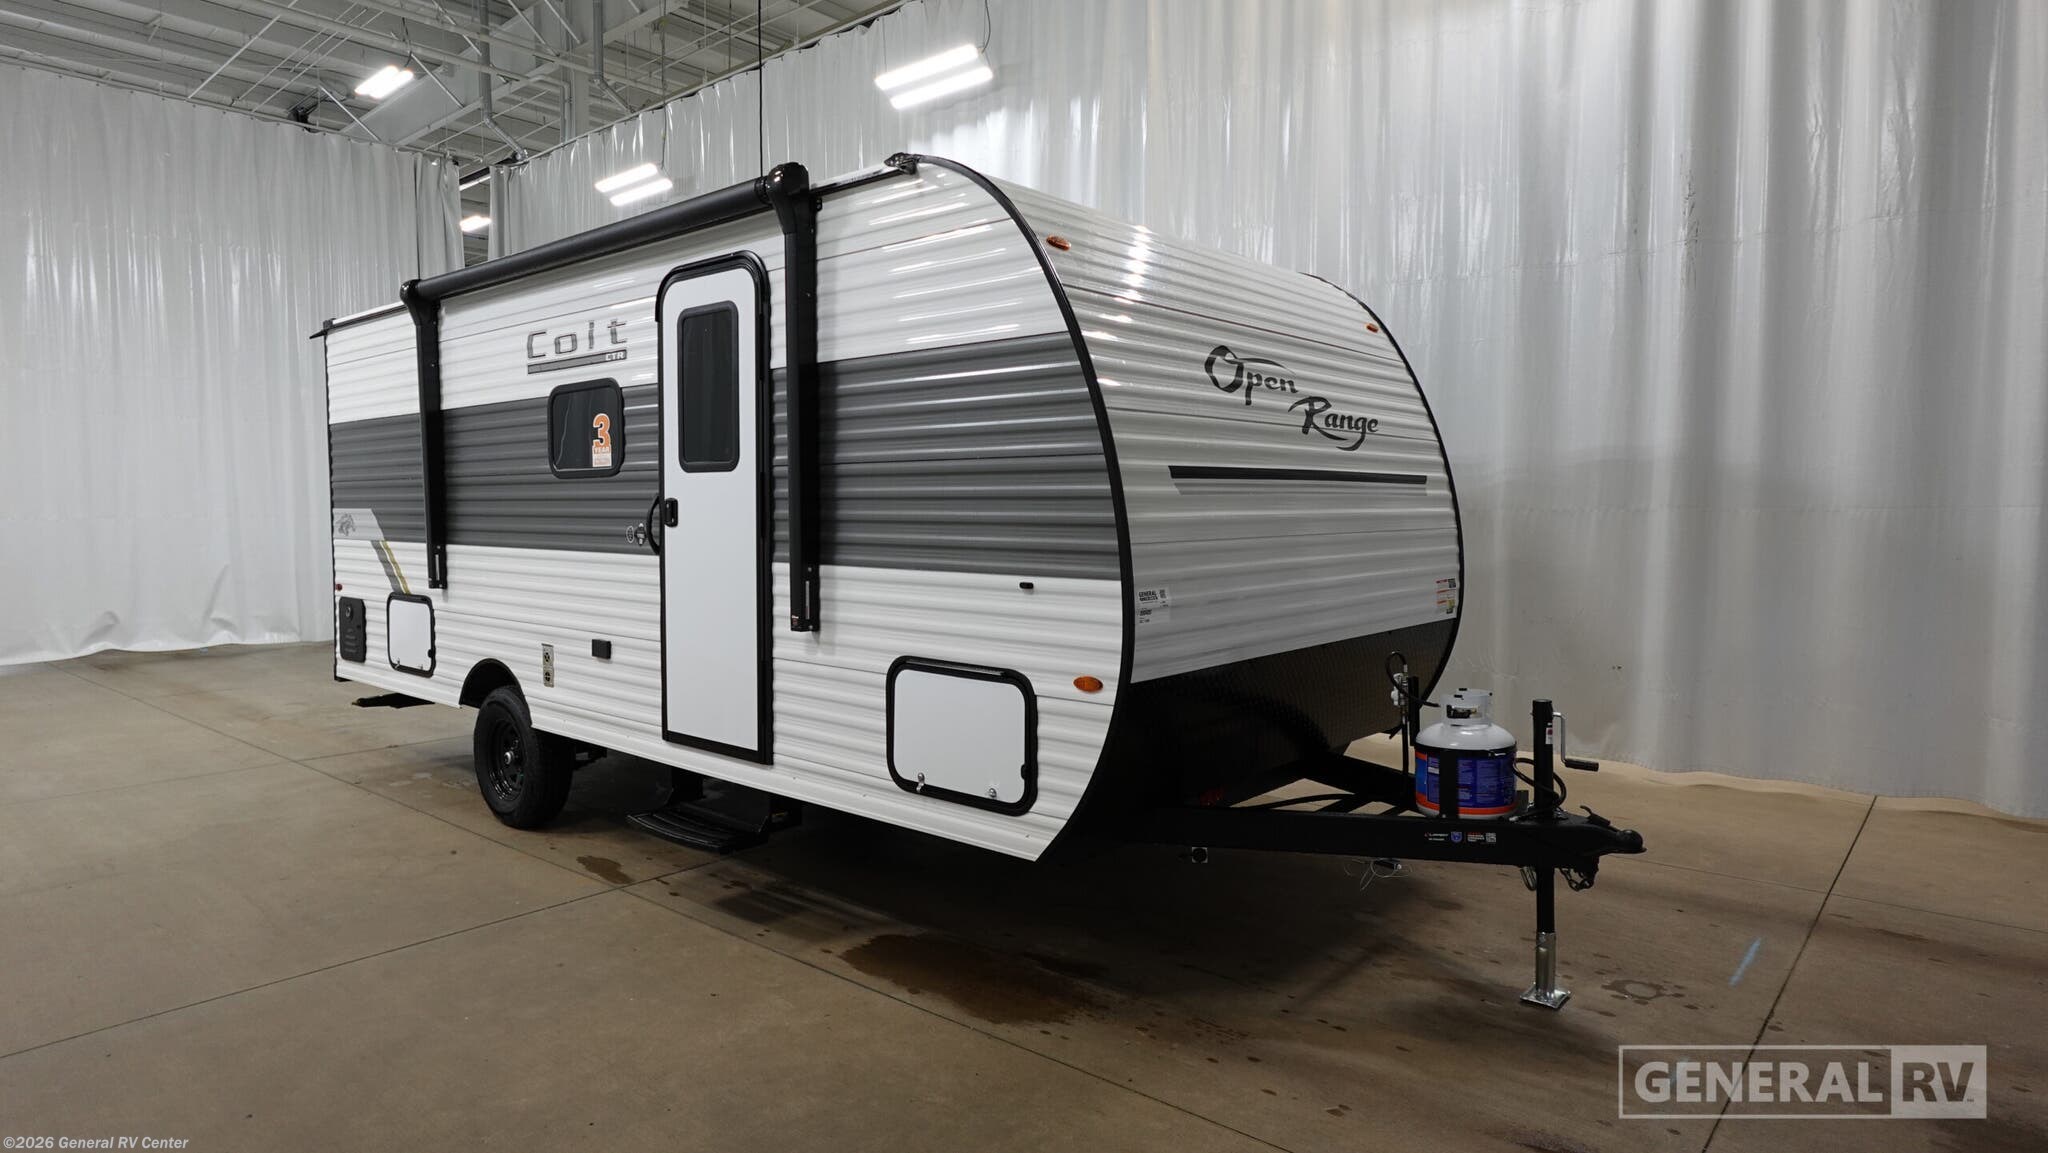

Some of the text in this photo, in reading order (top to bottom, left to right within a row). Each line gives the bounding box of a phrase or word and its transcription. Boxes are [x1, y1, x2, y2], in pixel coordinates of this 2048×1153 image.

[526, 319, 627, 359] Colt
[1204, 345, 1299, 406] Open
[592, 413, 611, 448] 3
[1288, 396, 1379, 451] Range
